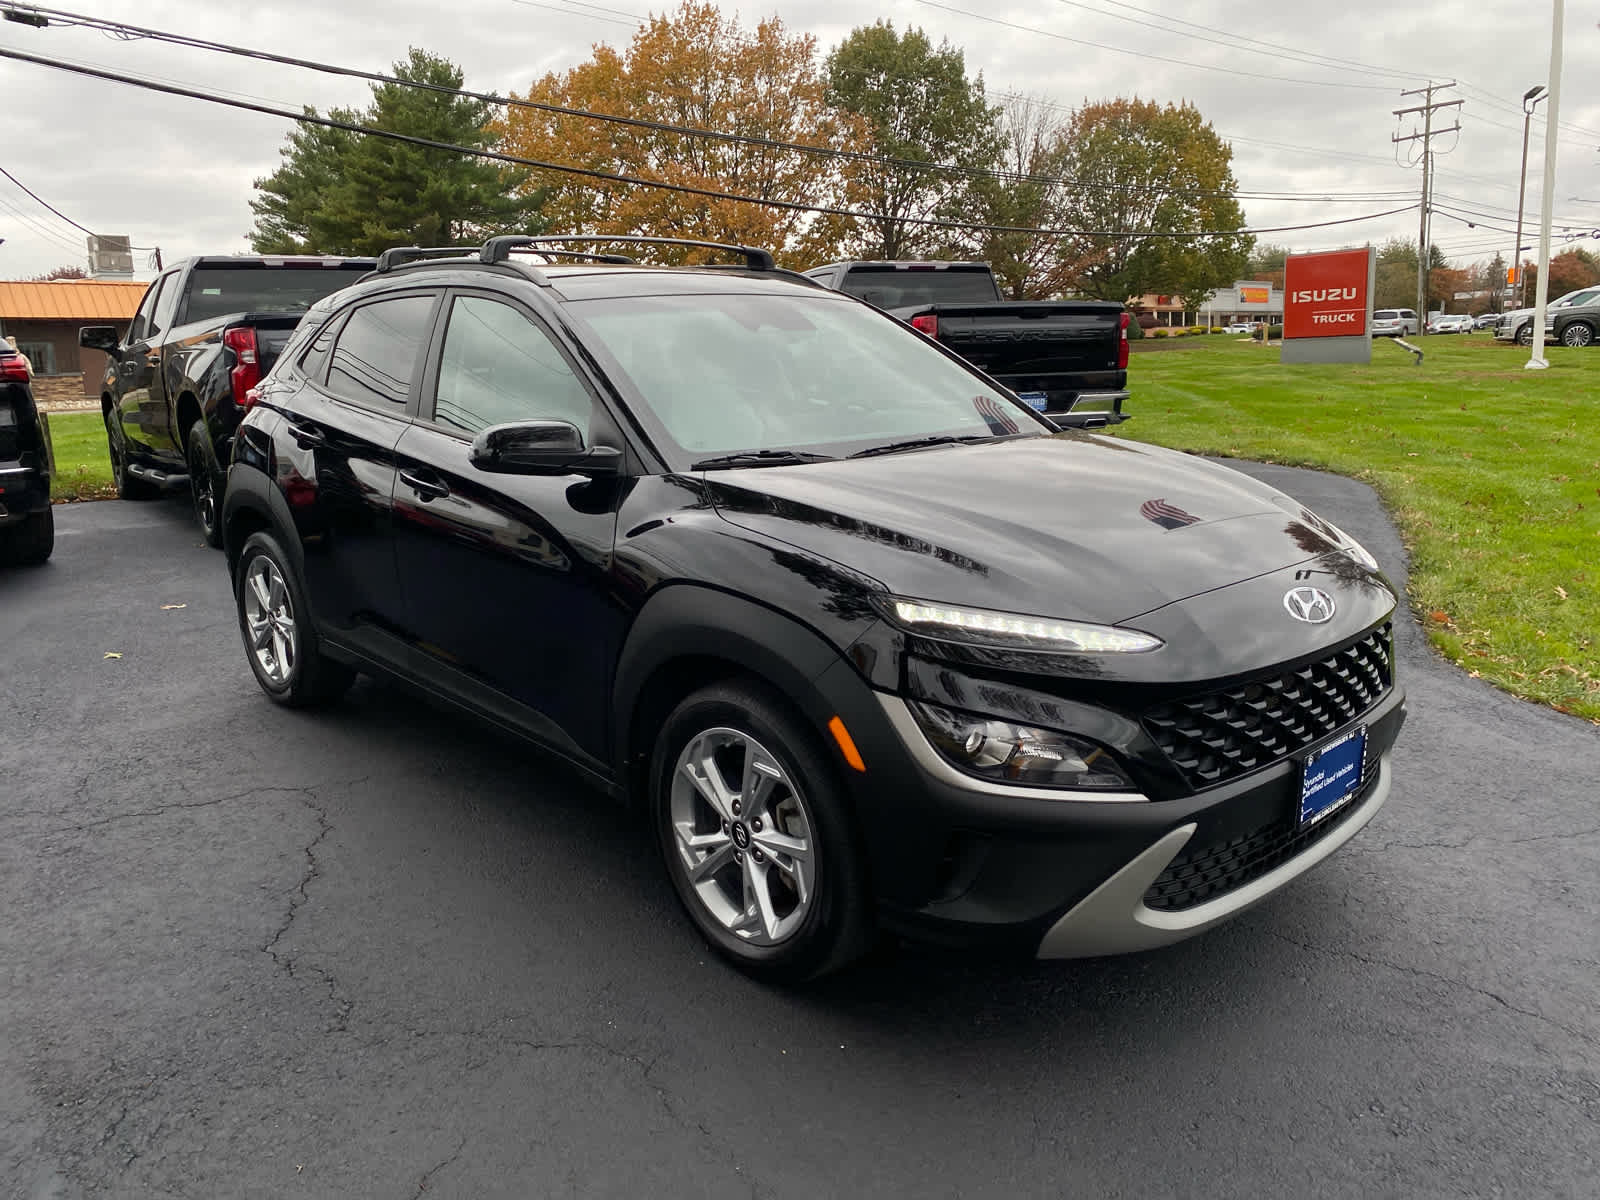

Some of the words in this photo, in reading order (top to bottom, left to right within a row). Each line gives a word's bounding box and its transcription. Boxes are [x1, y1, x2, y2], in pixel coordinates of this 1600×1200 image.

[1292, 287, 1357, 304] ISUZU
[1312, 313, 1356, 324] TRUCK
[1324, 773, 1336, 787] Used
[1336, 762, 1354, 779] Vehicles
